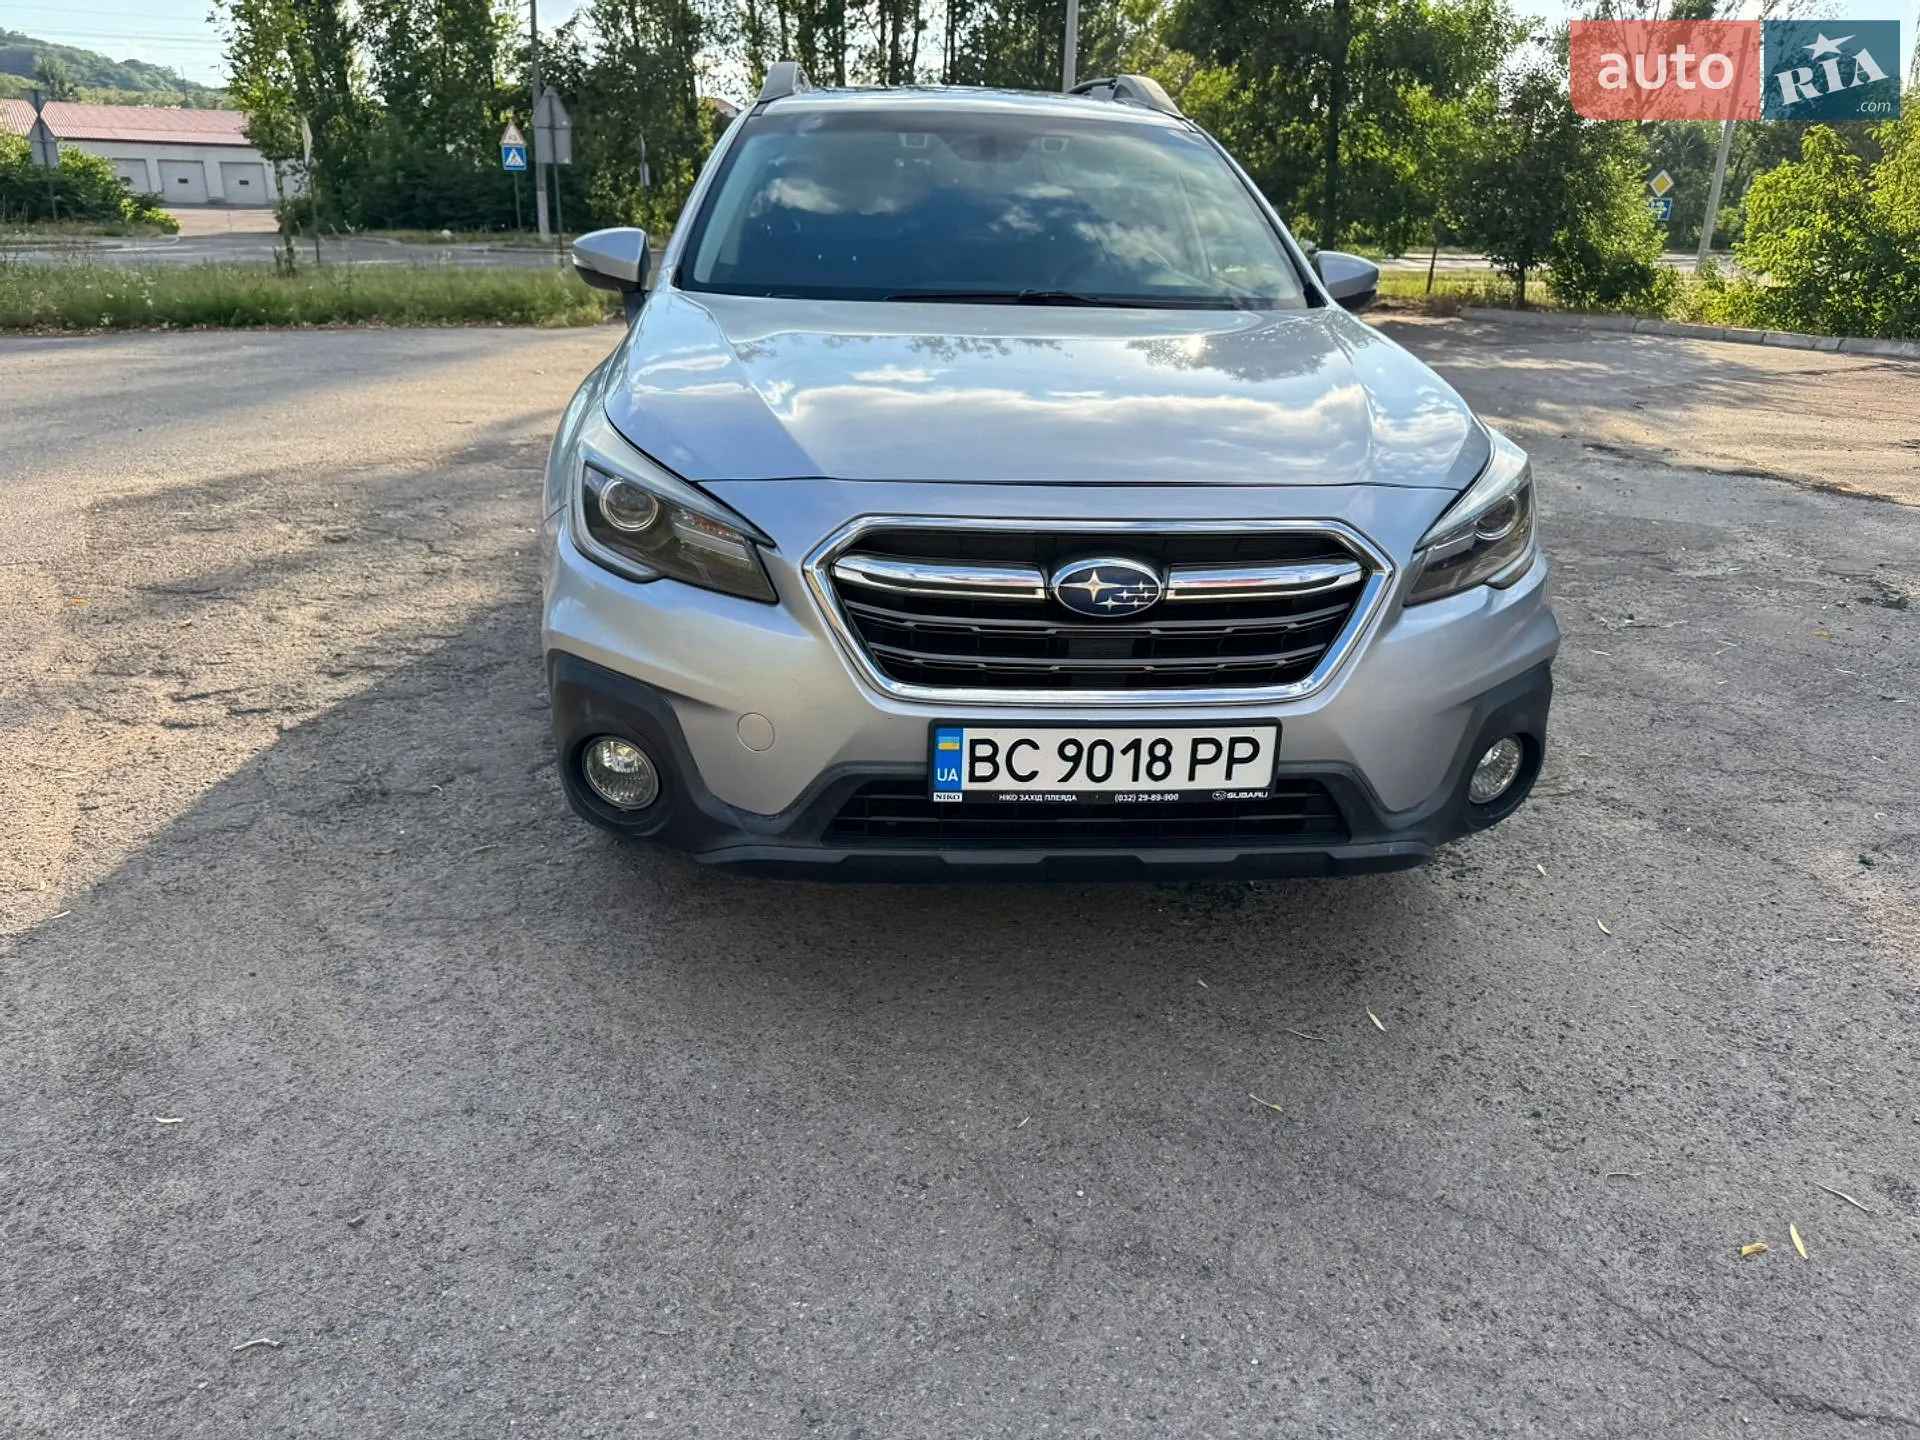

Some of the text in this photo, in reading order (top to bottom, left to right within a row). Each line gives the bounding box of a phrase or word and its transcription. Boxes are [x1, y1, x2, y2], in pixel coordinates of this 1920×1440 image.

[968, 736, 1260, 783] BC 9018 PP
[936, 767, 959, 782] UA
[1227, 791, 1268, 799] SUBARU
